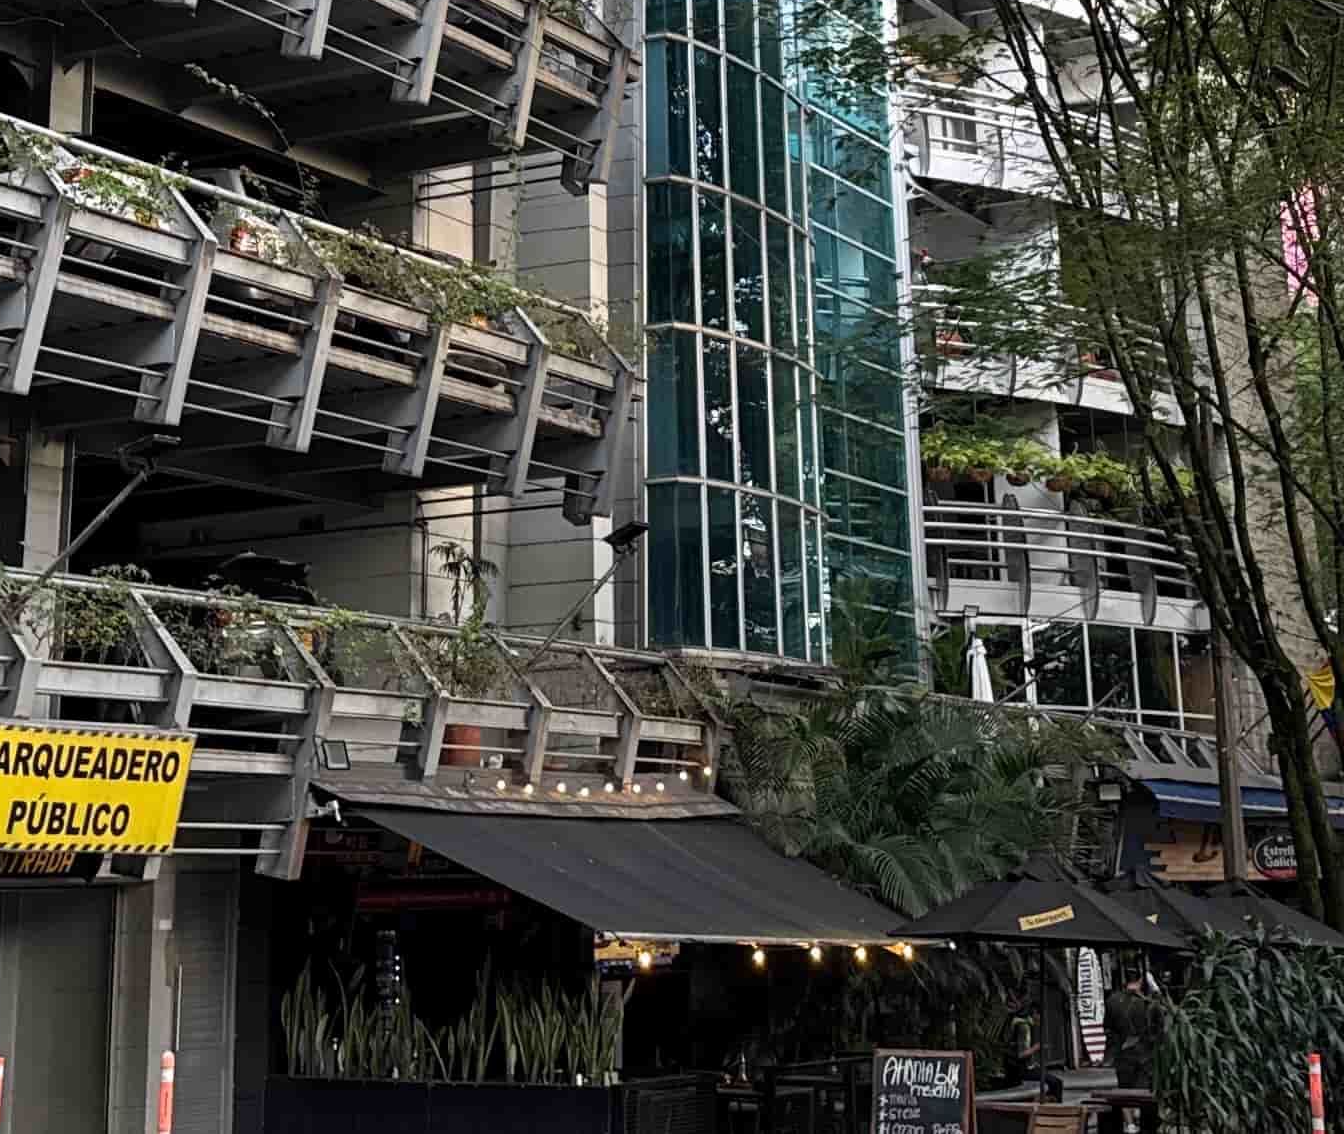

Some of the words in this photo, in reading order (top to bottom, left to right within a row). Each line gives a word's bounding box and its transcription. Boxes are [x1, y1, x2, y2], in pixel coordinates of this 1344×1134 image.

[6, 793, 130, 837] PÚBLICO
[0, 849, 76, 875] NTRADA
[1263, 845, 1296, 856] Estrell
